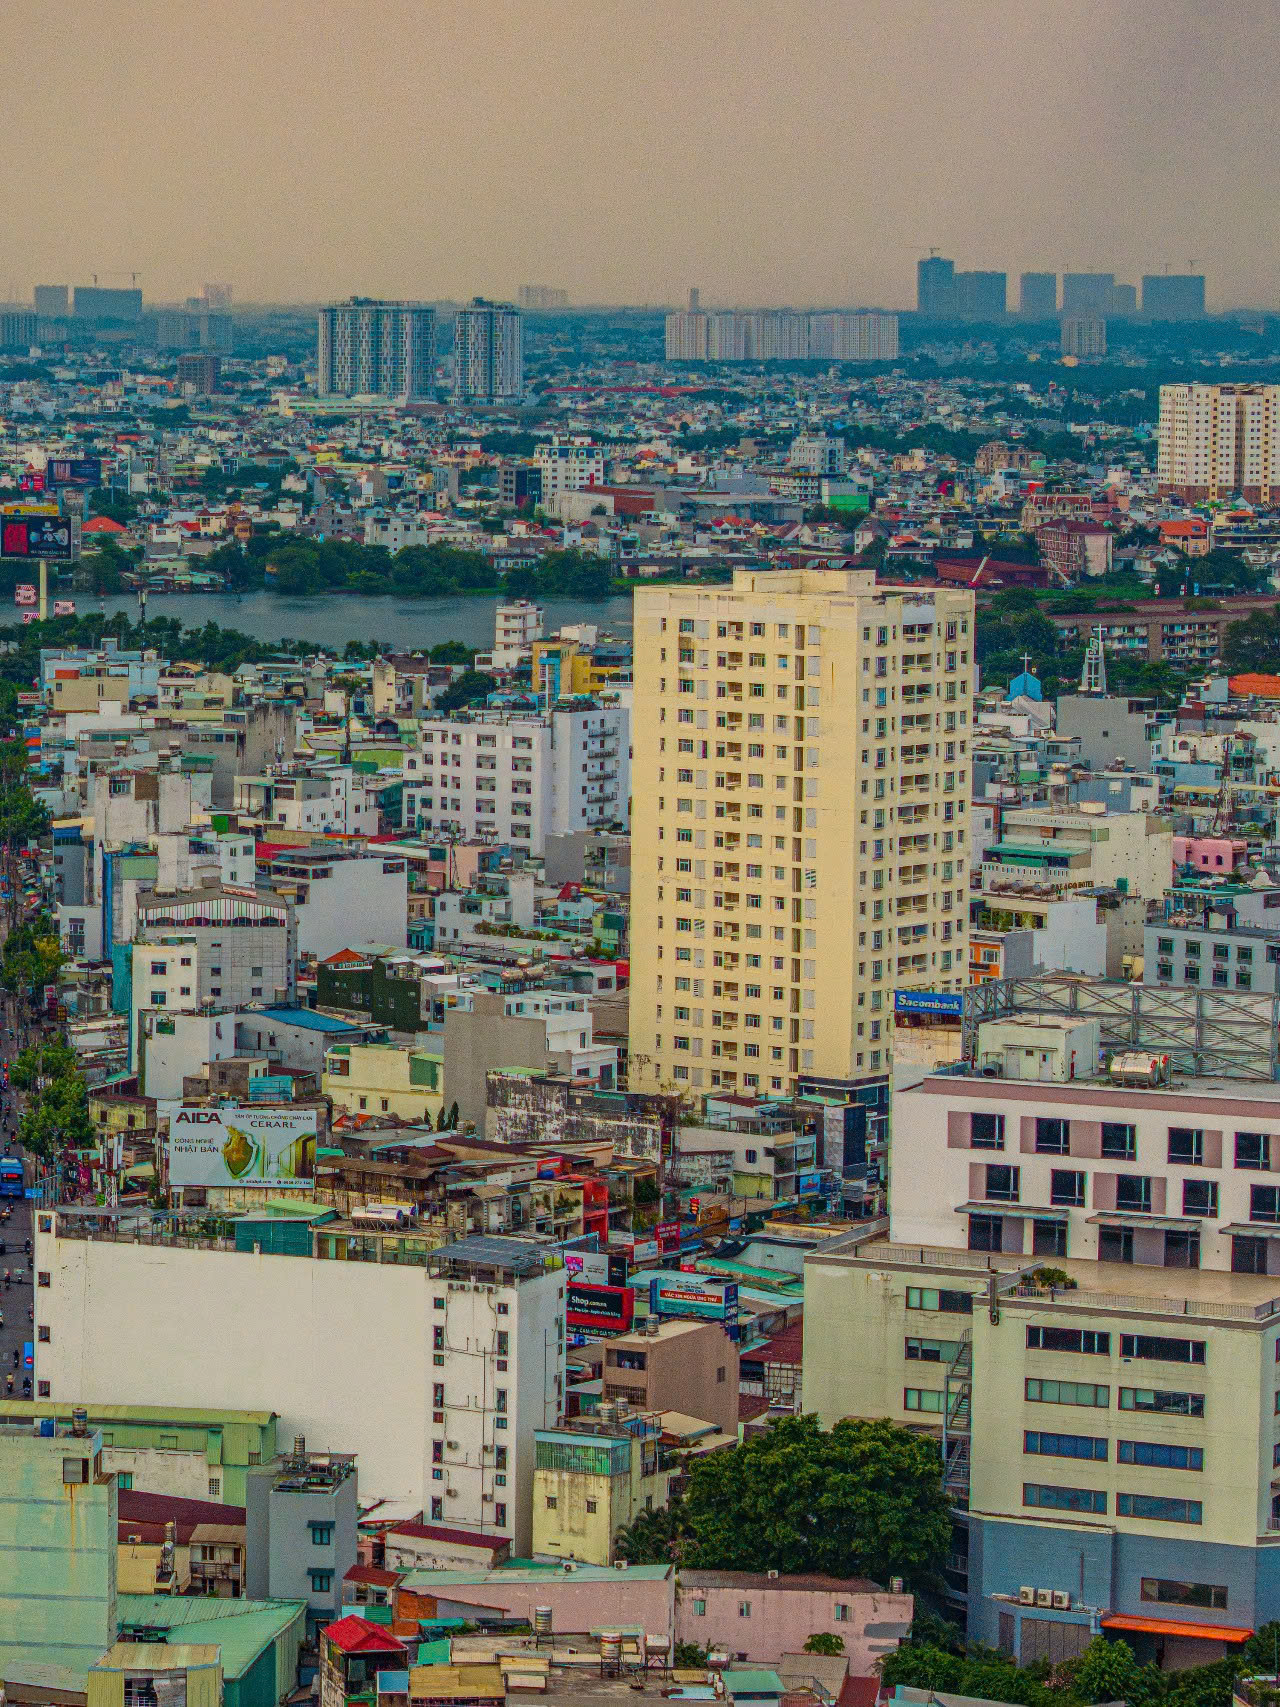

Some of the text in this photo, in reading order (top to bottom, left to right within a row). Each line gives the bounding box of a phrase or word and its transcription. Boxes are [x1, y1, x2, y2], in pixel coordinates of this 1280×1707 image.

[898, 994, 959, 1010] Sacombank
[176, 1112, 222, 1124] AICA
[250, 1120, 296, 1128] CERARL
